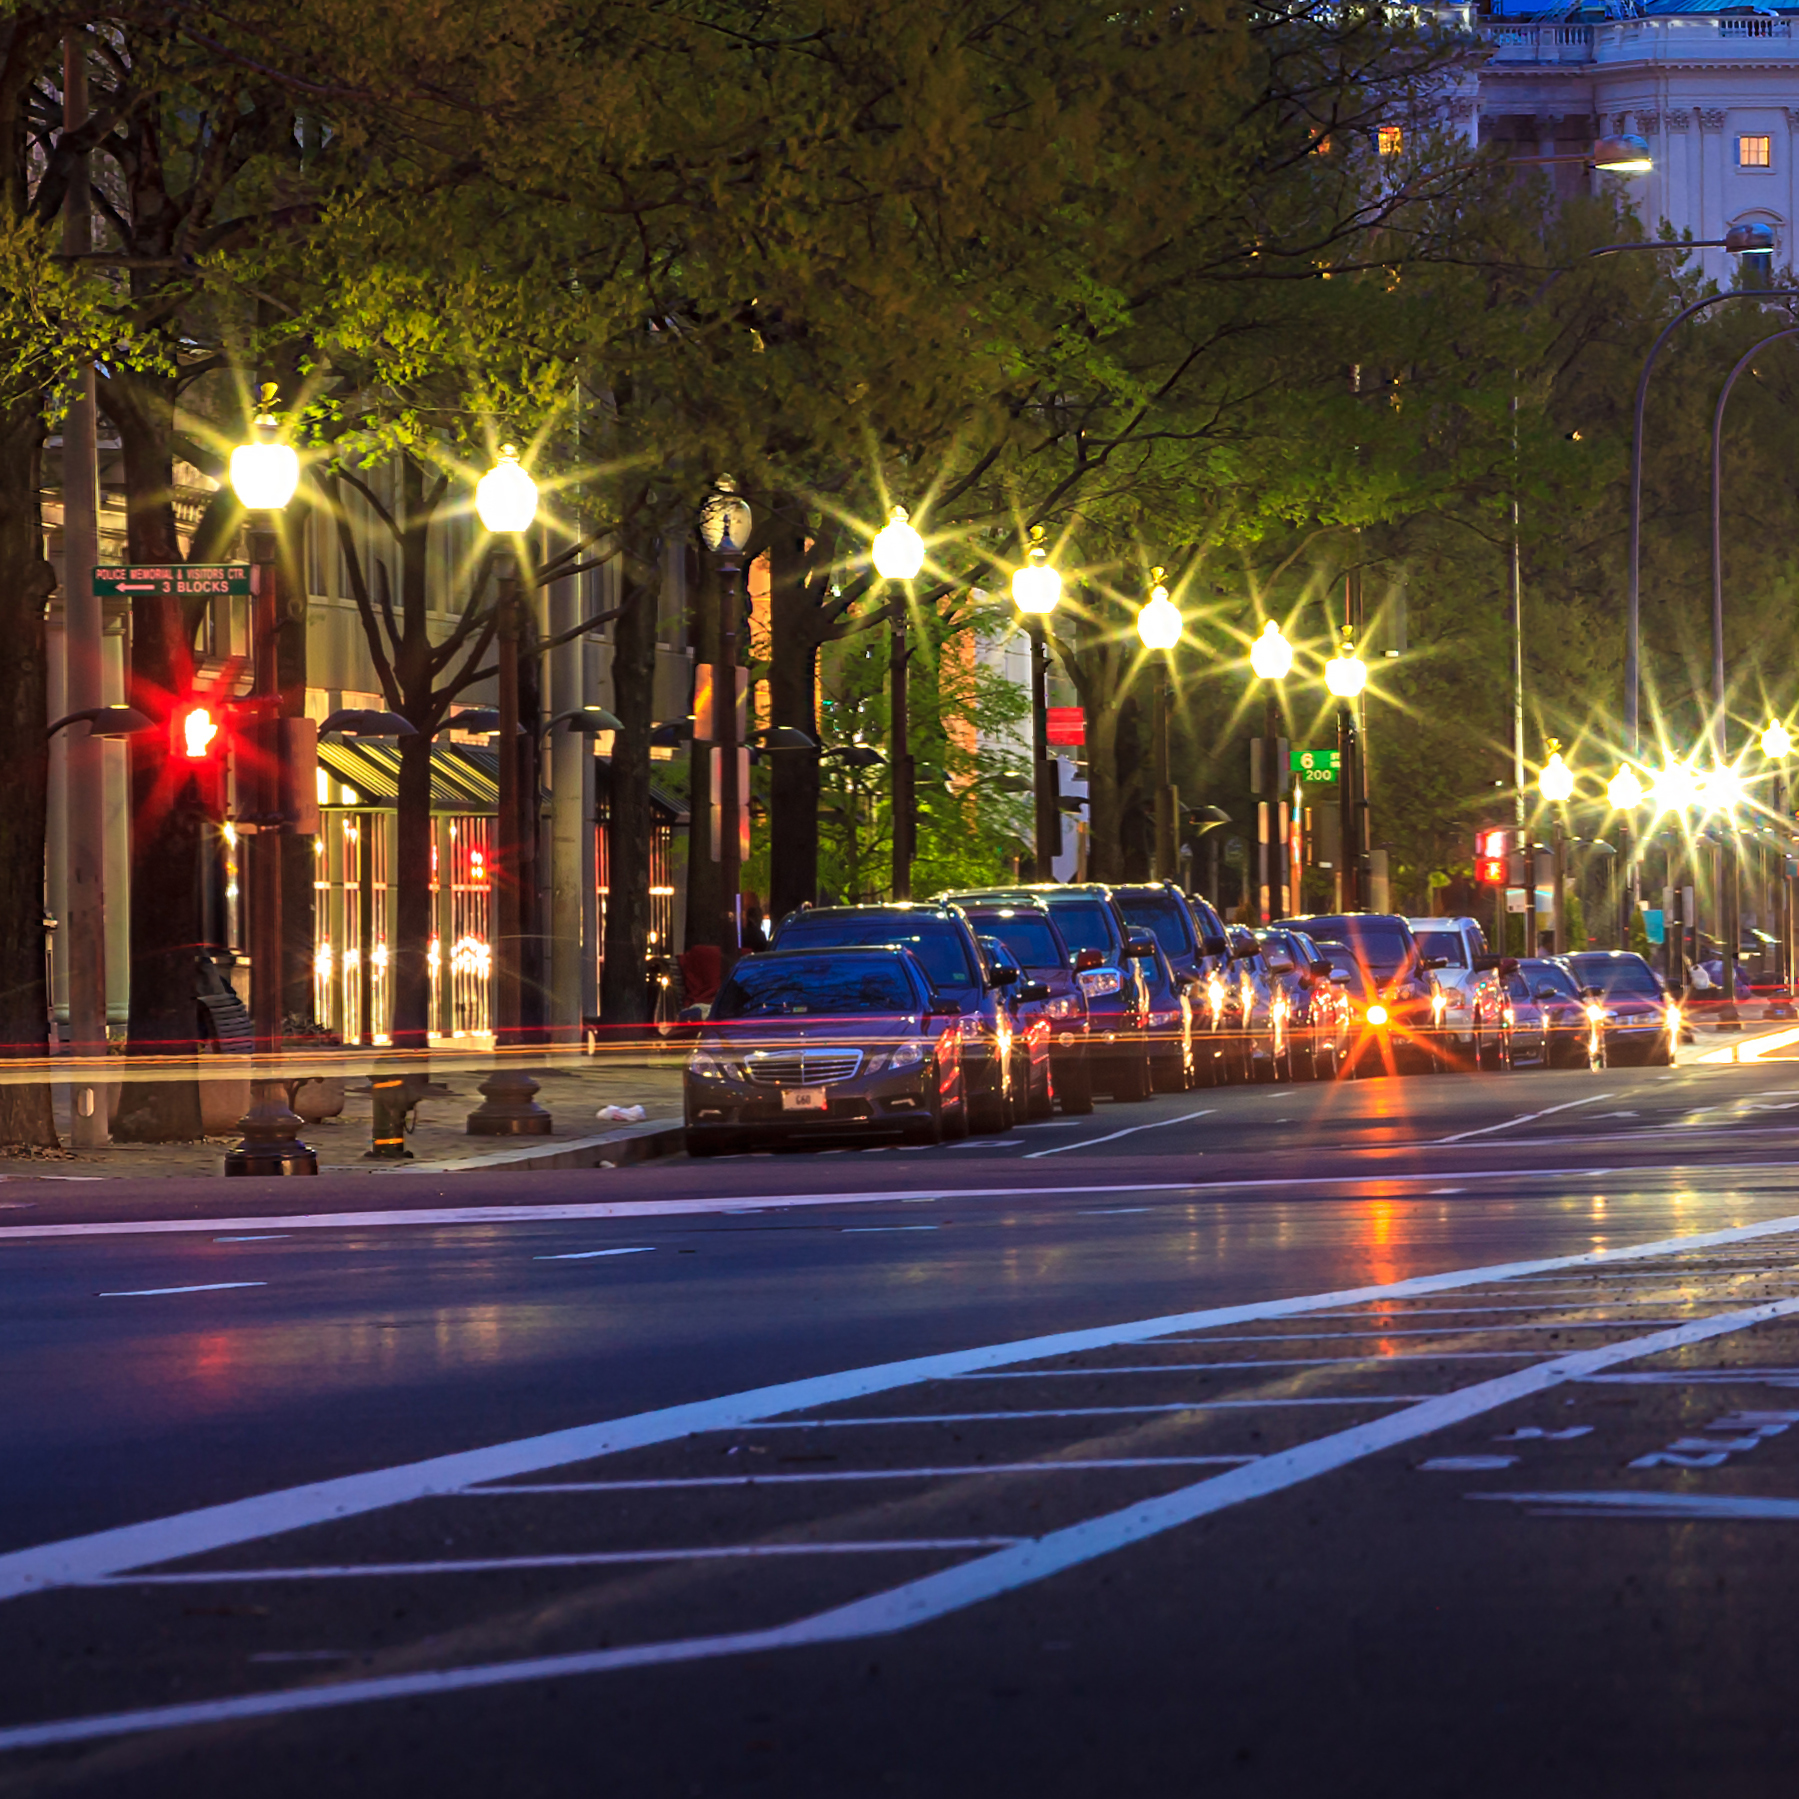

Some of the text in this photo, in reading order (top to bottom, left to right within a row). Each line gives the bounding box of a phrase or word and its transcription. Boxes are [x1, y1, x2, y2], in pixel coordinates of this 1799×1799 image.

[95, 568, 247, 580] POLICE MEMORIAL & VISITORS CTR.
[162, 581, 229, 593] 3 BLOCKS
[1300, 752, 1314, 769] 6
[1306, 770, 1332, 781] 200
